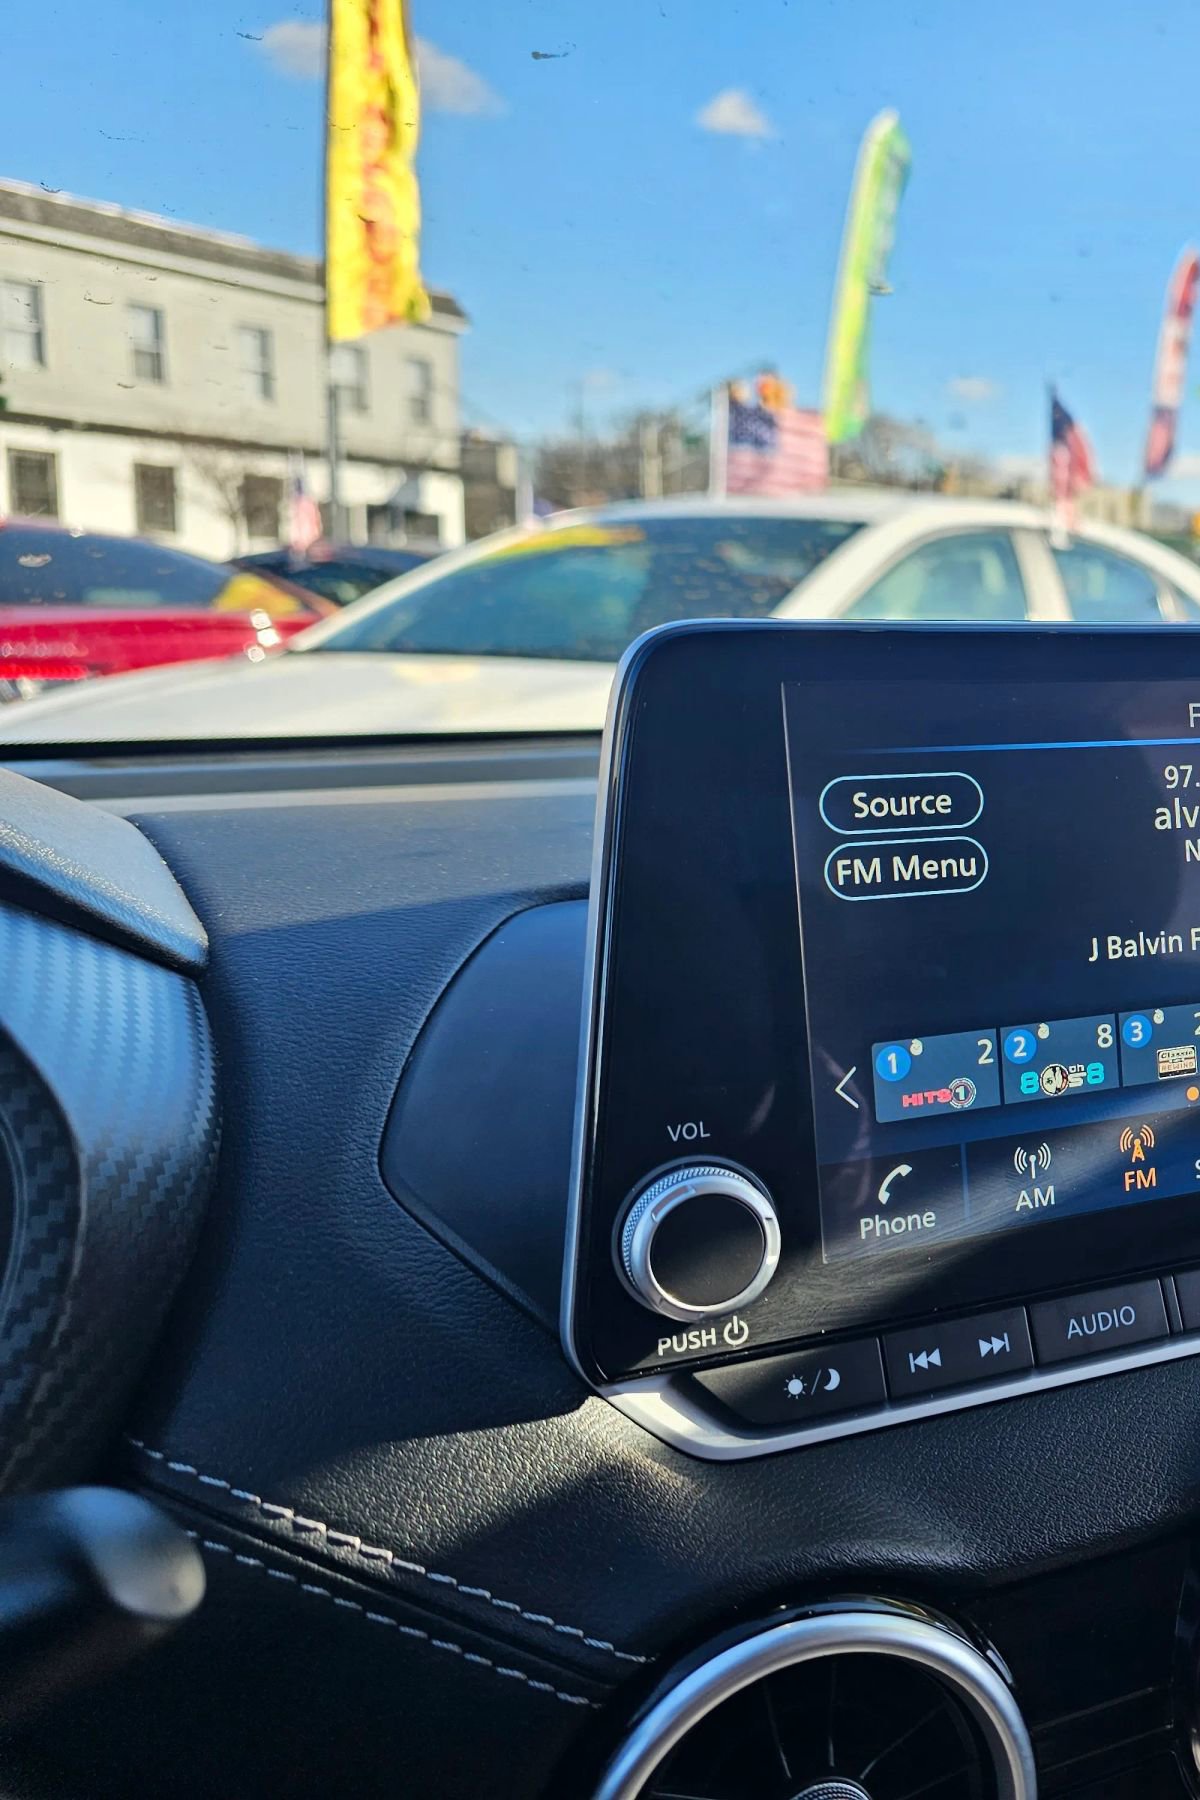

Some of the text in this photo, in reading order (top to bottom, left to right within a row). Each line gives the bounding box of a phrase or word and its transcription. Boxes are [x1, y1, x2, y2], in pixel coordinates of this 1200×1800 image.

[853, 790, 952, 819] Source
[836, 854, 977, 886] FM Menu
[1088, 938, 1099, 962] J
[1107, 930, 1183, 960] Balvin
[1096, 1023, 1113, 1049] 8
[1130, 1021, 1144, 1043] 3
[977, 1038, 994, 1065] 2
[1013, 1036, 1027, 1058] 2
[887, 1052, 898, 1075] 1
[666, 1121, 711, 1142] VOL
[1124, 1167, 1158, 1192] FM
[1015, 1185, 1056, 1212] AM
[859, 1210, 936, 1240] Phone
[1066, 1304, 1137, 1341] AUDIO
[656, 1327, 717, 1356] PUSH
